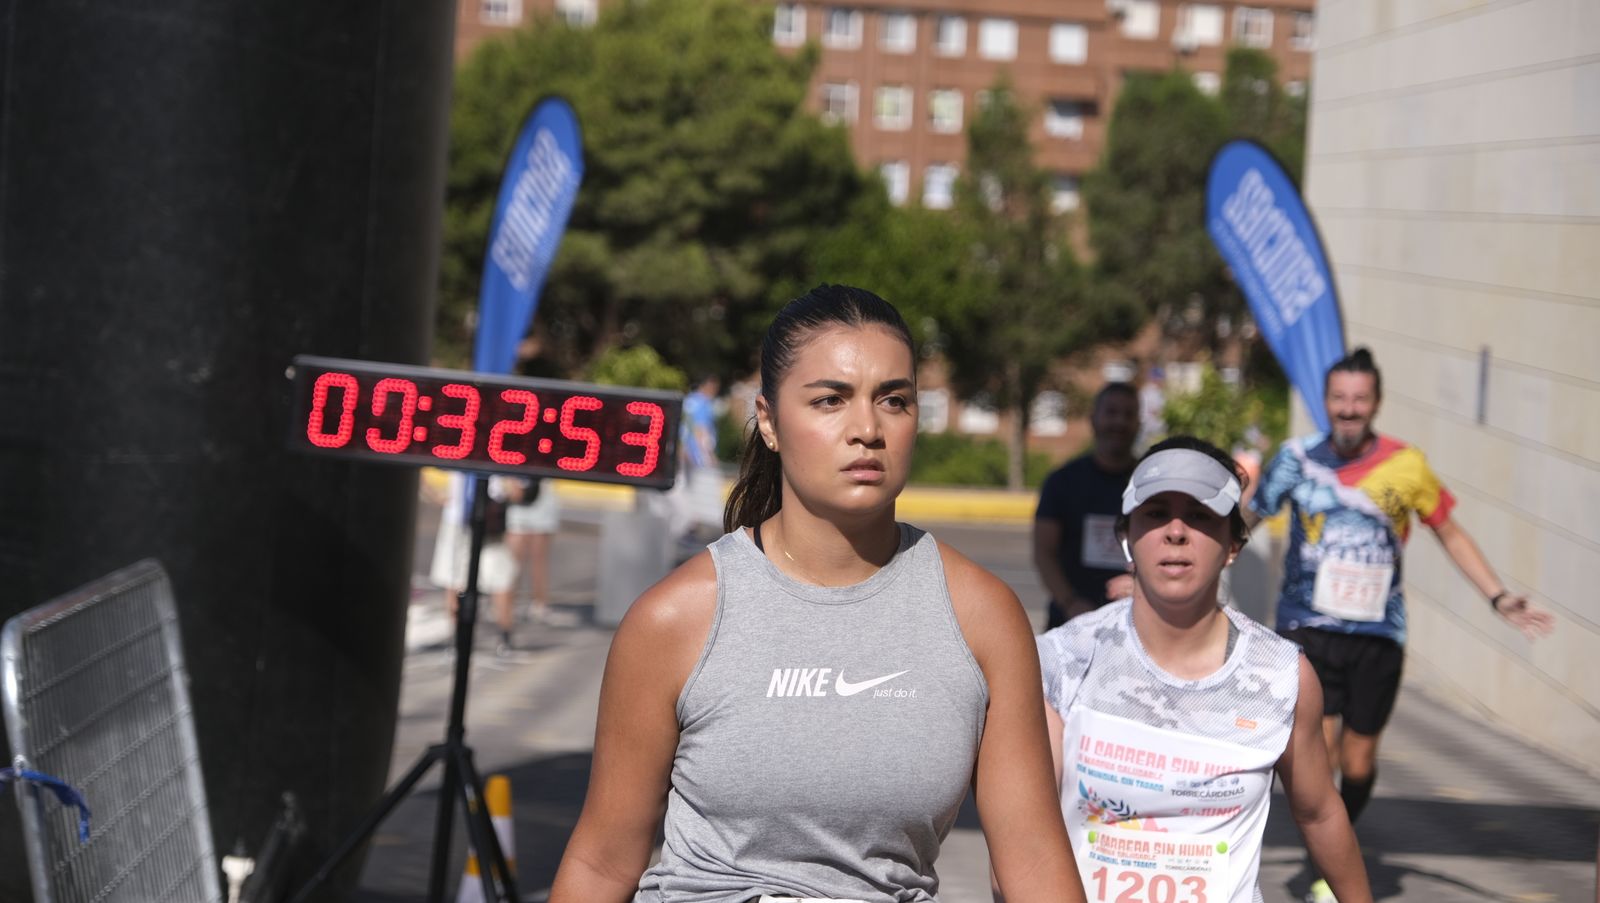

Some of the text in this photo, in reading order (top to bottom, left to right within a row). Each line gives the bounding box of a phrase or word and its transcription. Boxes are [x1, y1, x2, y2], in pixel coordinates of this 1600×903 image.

[765, 668, 832, 698] NIKE
[873, 687, 893, 699] just
[894, 688, 908, 698] do
[1095, 740, 1167, 771] CARRERA
[1171, 757, 1200, 775] SIN
[1100, 833, 1150, 853] CARRERA
[1154, 842, 1175, 855] SIN
[1179, 844, 1213, 857] HUMO
[1092, 866, 1208, 903] 1203
